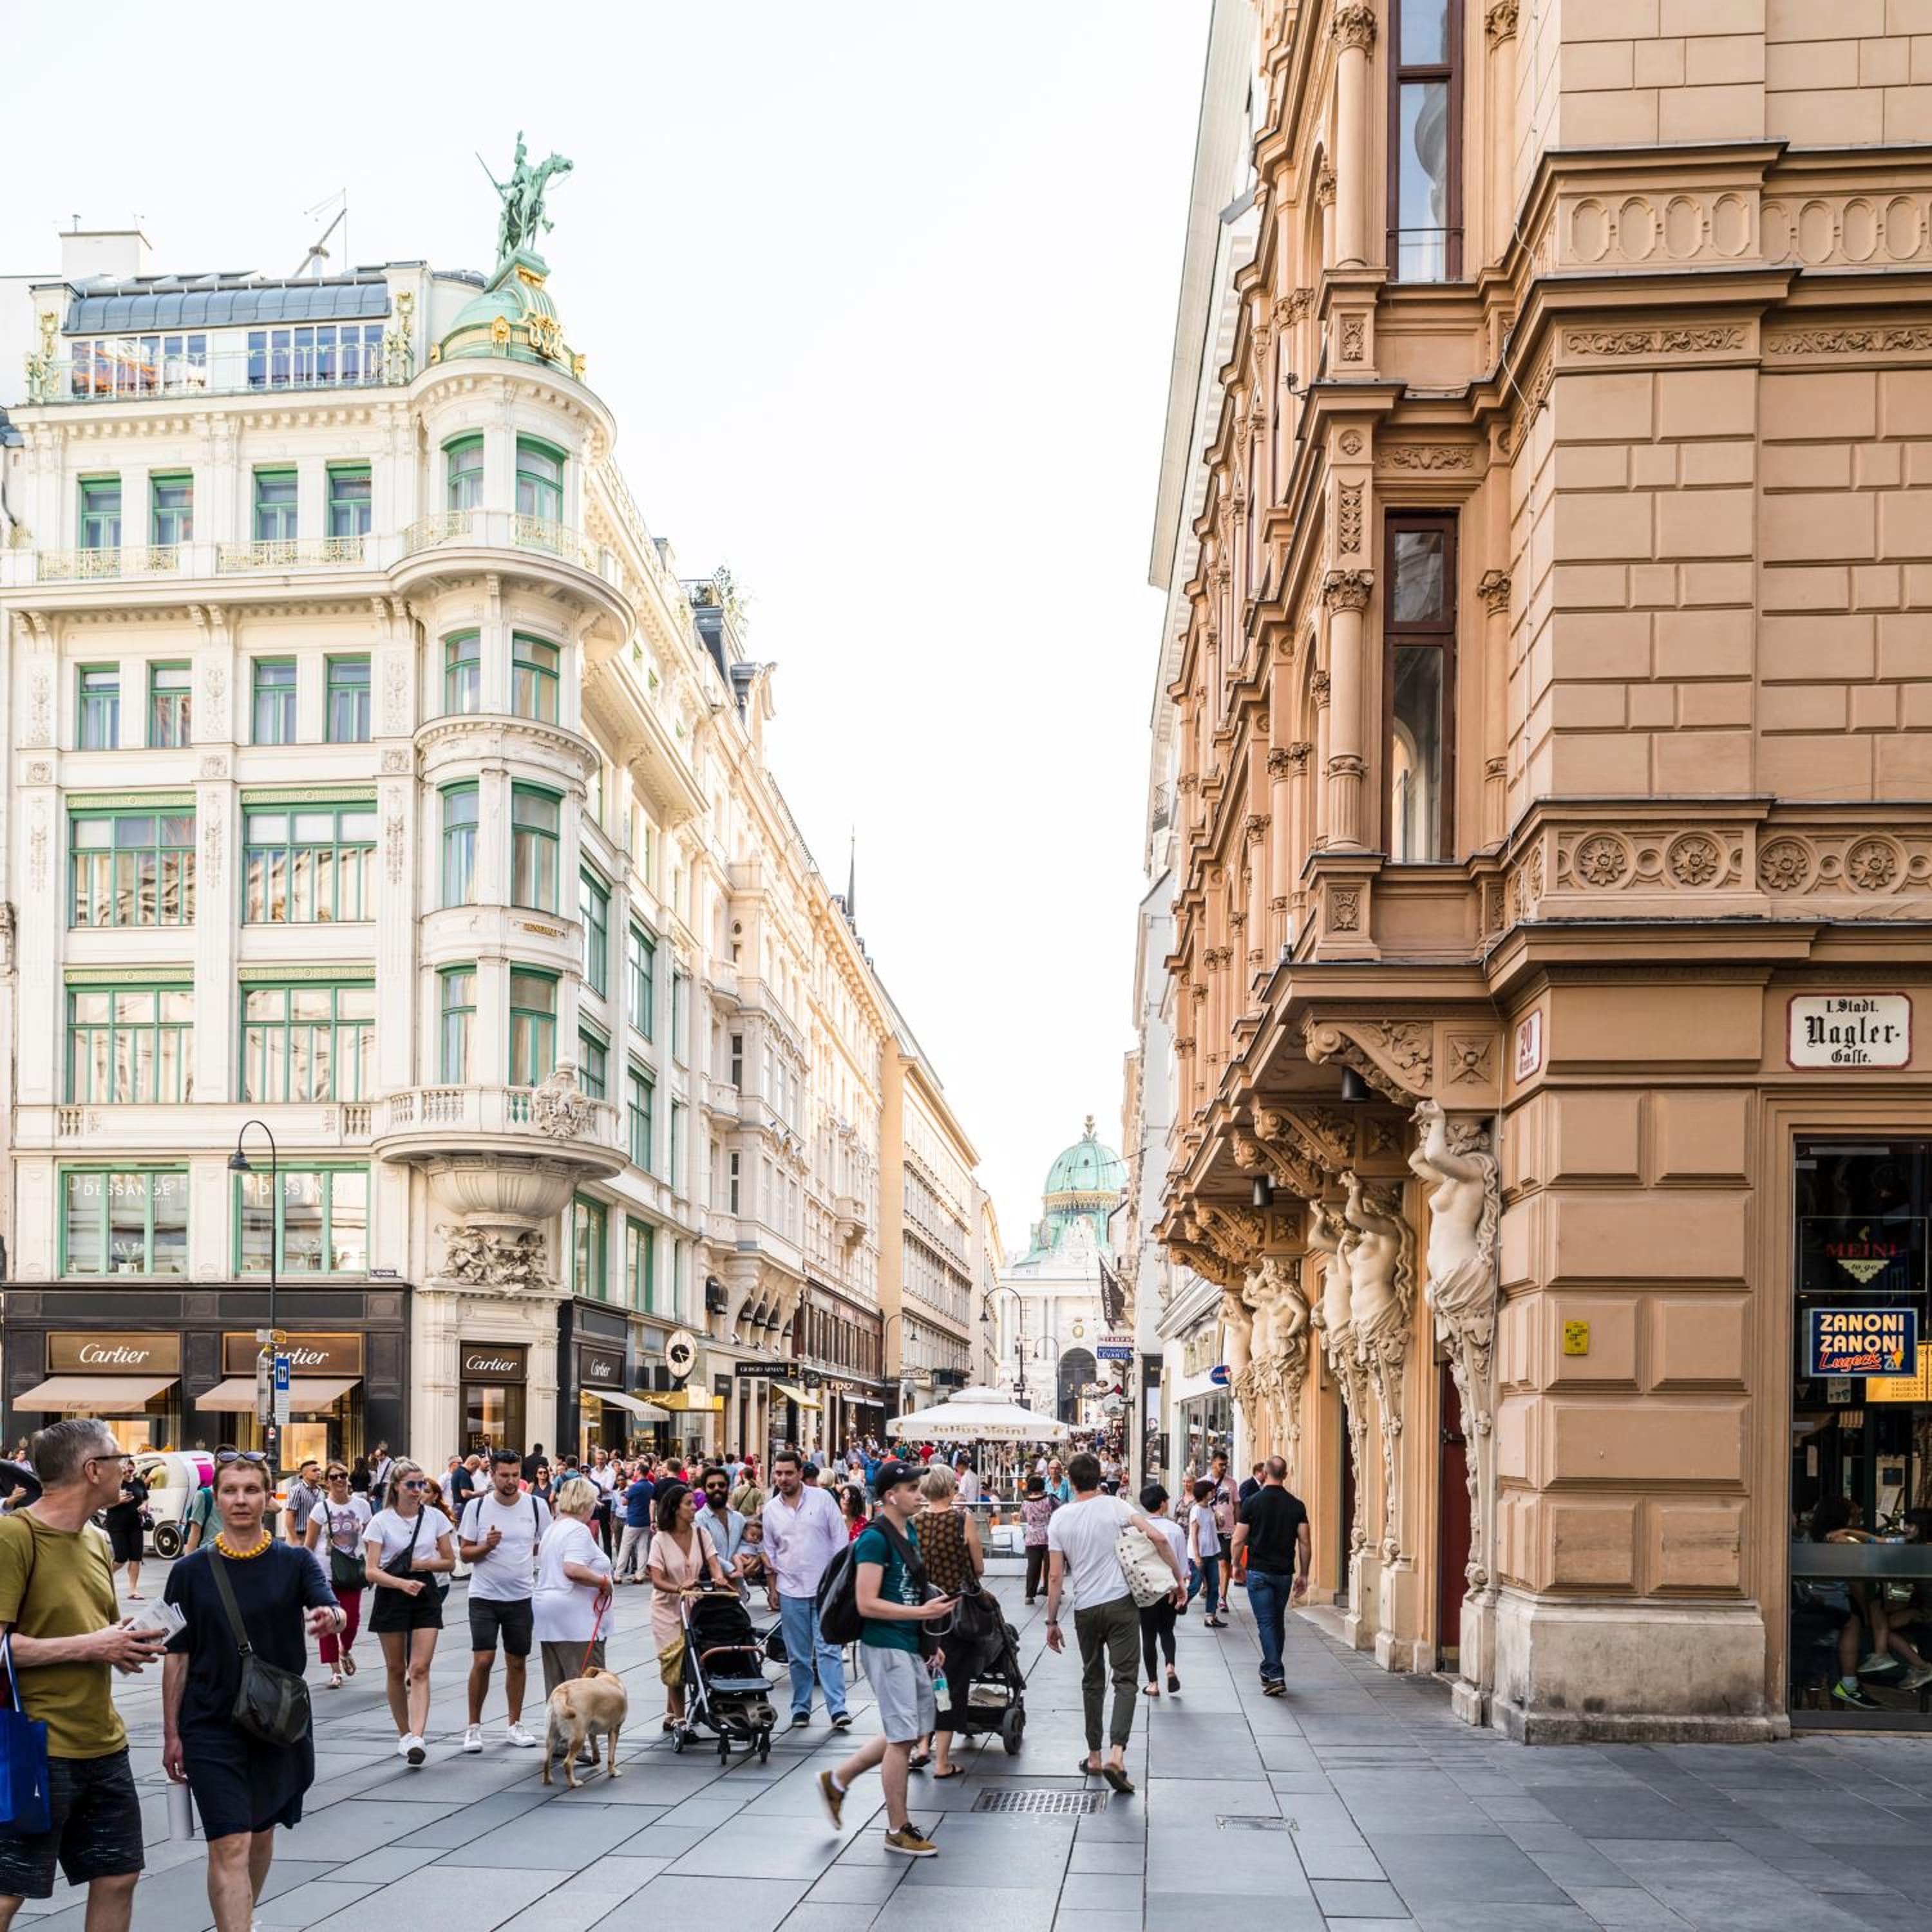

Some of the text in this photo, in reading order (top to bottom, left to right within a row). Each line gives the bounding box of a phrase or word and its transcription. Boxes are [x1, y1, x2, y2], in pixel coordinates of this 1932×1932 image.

[1520, 1019, 1532, 1056] 20
[1805, 1016, 1900, 1049] Nagler-
[1819, 1314, 1904, 1332] ZANONI
[1819, 1334, 1904, 1352] ZANONI
[80, 1343, 149, 1363] Cartier
[466, 1354, 517, 1371] Cartier
[591, 1359, 611, 1376] Cartier
